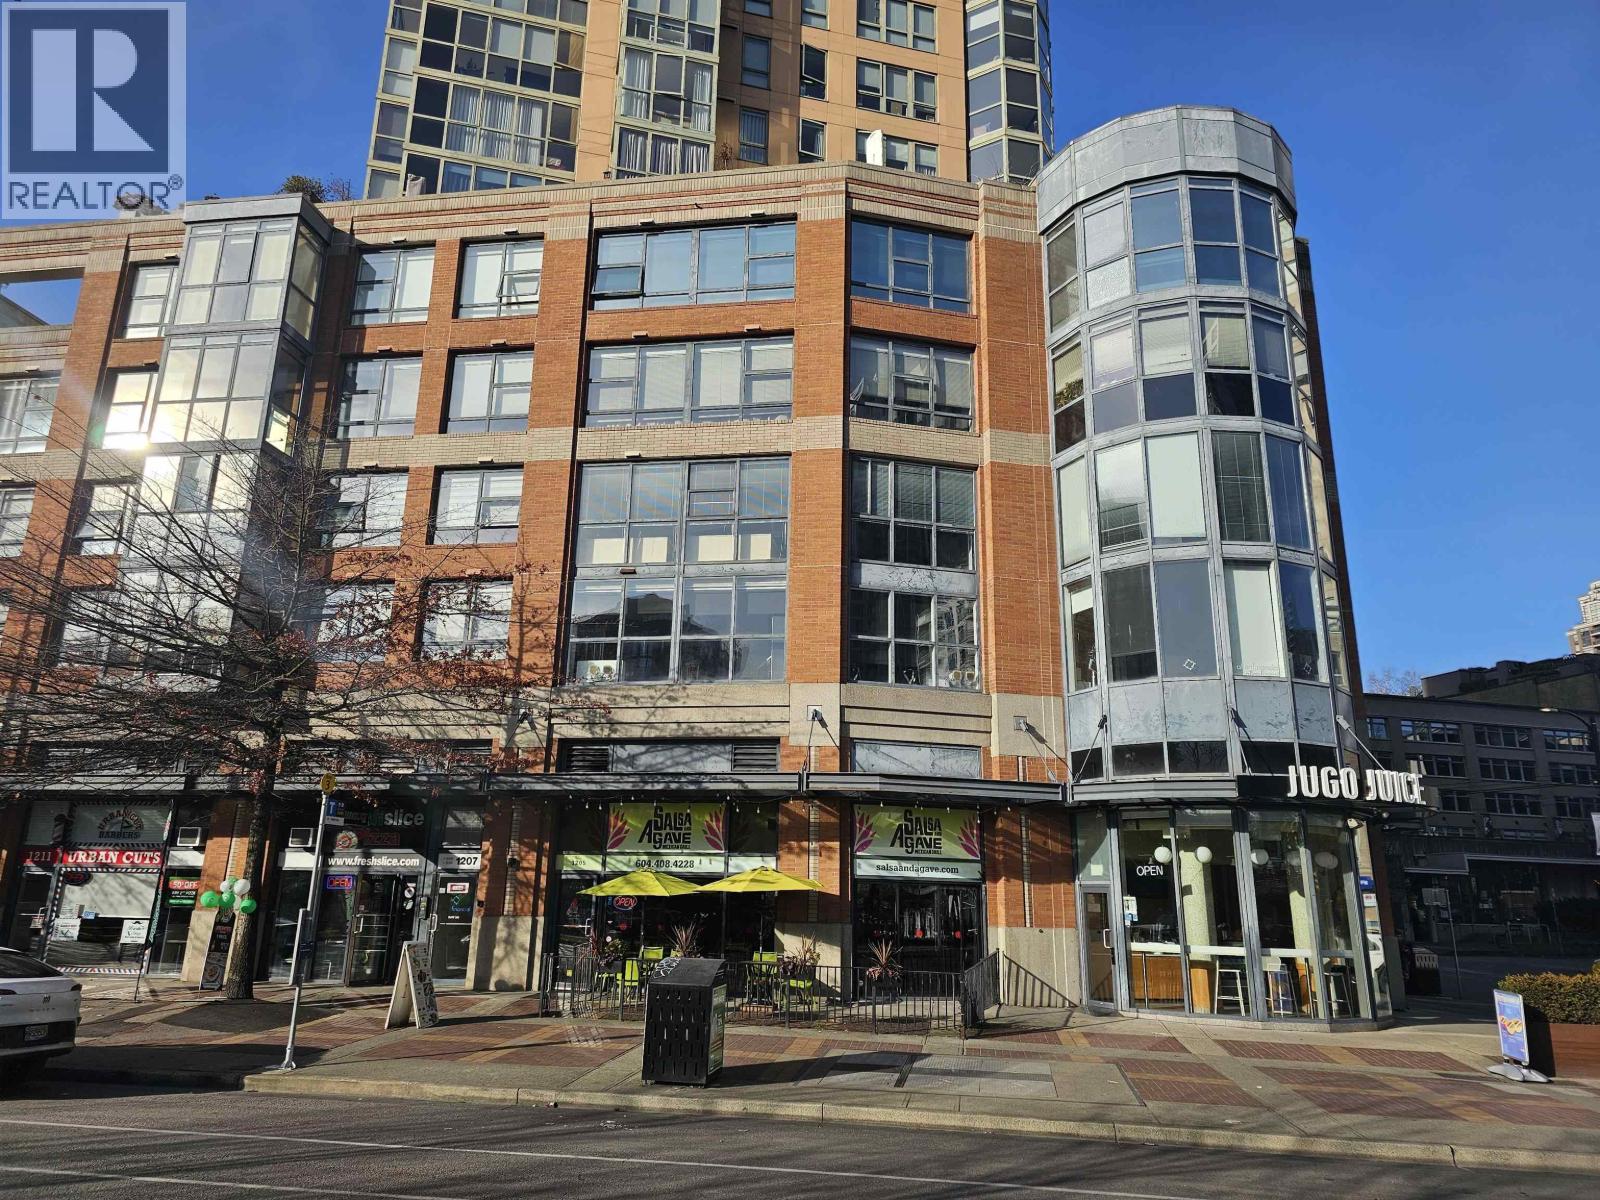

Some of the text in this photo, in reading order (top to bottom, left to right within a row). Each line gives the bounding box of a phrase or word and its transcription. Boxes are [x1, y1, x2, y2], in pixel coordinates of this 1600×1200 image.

[1287, 765, 1426, 805] JUGO JUICE
[903, 809, 942, 835] SALSA
[638, 819, 692, 849] AGAVE
[890, 823, 942, 854] AGAVE
[28, 851, 52, 861] 1211
[67, 851, 161, 864] URBAN CUTS
[328, 855, 420, 867] www.freshslice.com
[456, 857, 478, 865] 1207
[635, 859, 695, 868] 604.408.4228
[876, 863, 959, 874] salsaandagave.com
[1136, 865, 1163, 876] OPEN
[616, 897, 635, 907] OPEN
